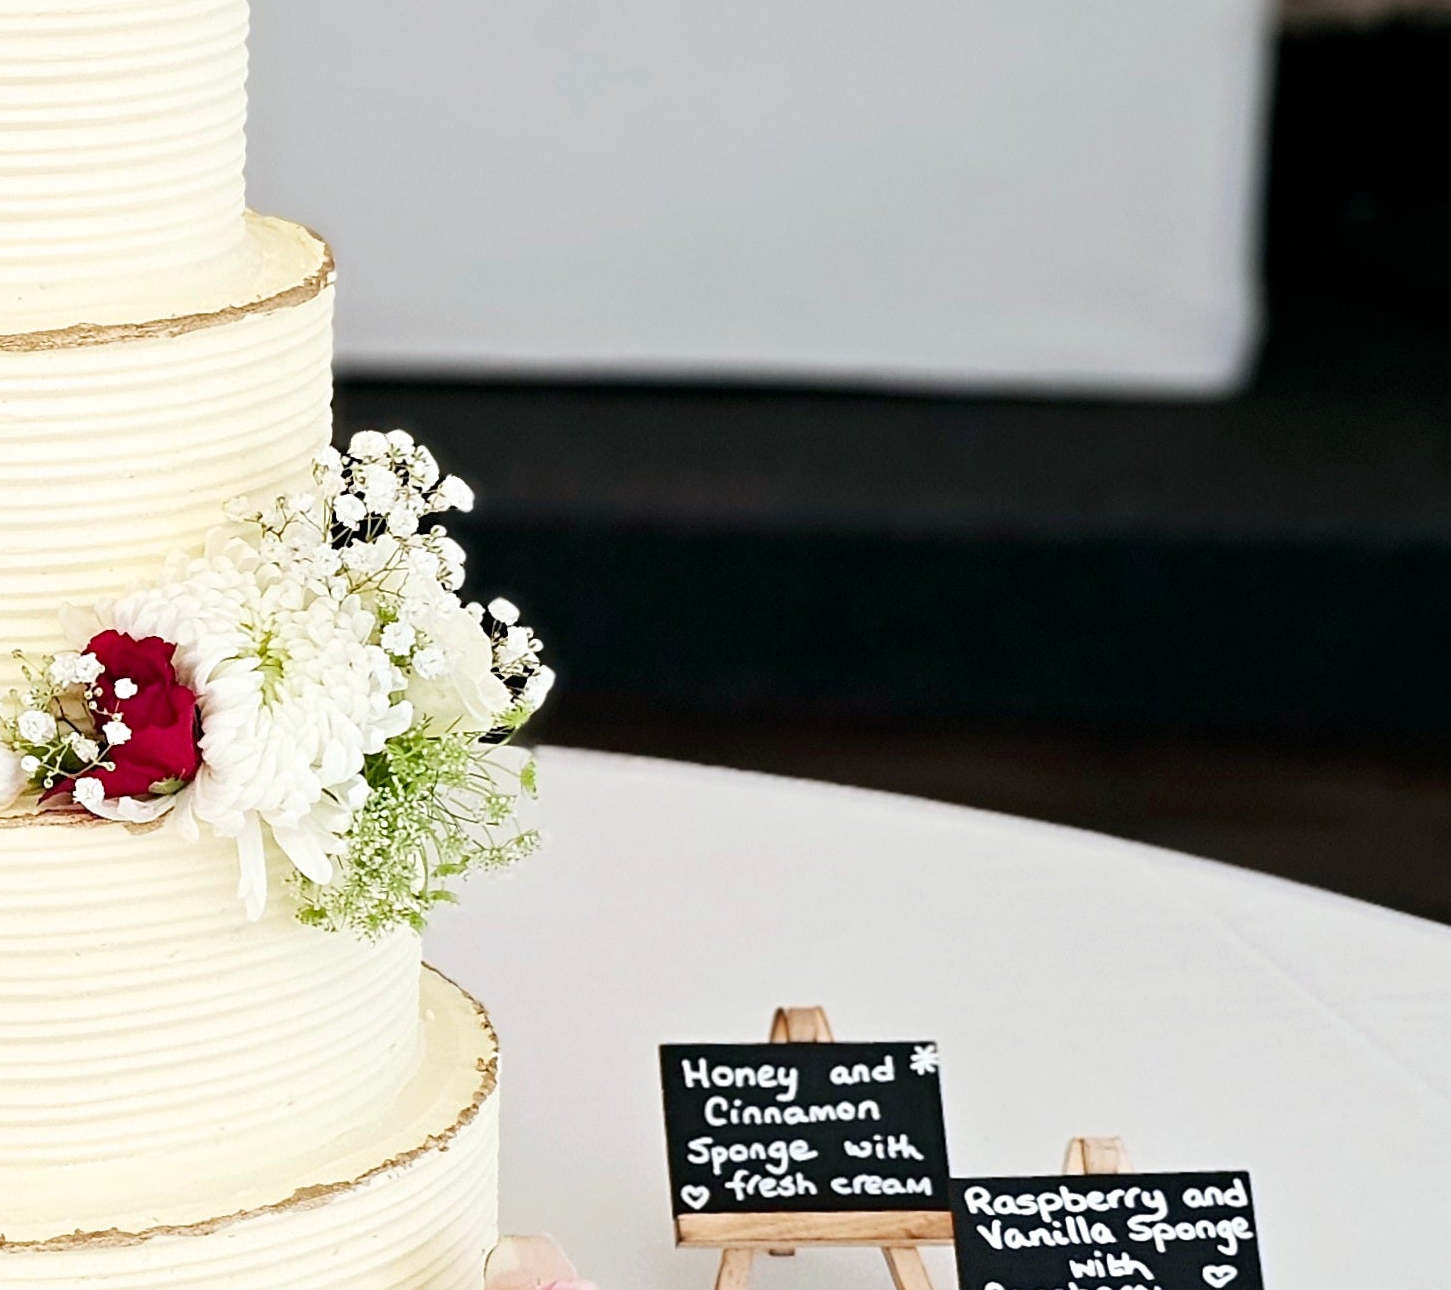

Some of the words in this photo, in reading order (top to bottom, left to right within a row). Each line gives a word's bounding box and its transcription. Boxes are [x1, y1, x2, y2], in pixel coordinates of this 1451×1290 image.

[682, 1058, 797, 1101] Honey
[829, 1056, 894, 1084] and
[704, 1096, 880, 1126] Cinnamon
[687, 1136, 818, 1176] Sponge
[844, 1134, 924, 1160] with
[725, 1170, 817, 1201] fresh
[964, 1186, 1168, 1223] Raspberry
[1182, 1178, 1248, 1208] and
[977, 1216, 1117, 1249] Vanilla
[1127, 1216, 1253, 1256] Sponge
[1069, 1251, 1154, 1280] with
